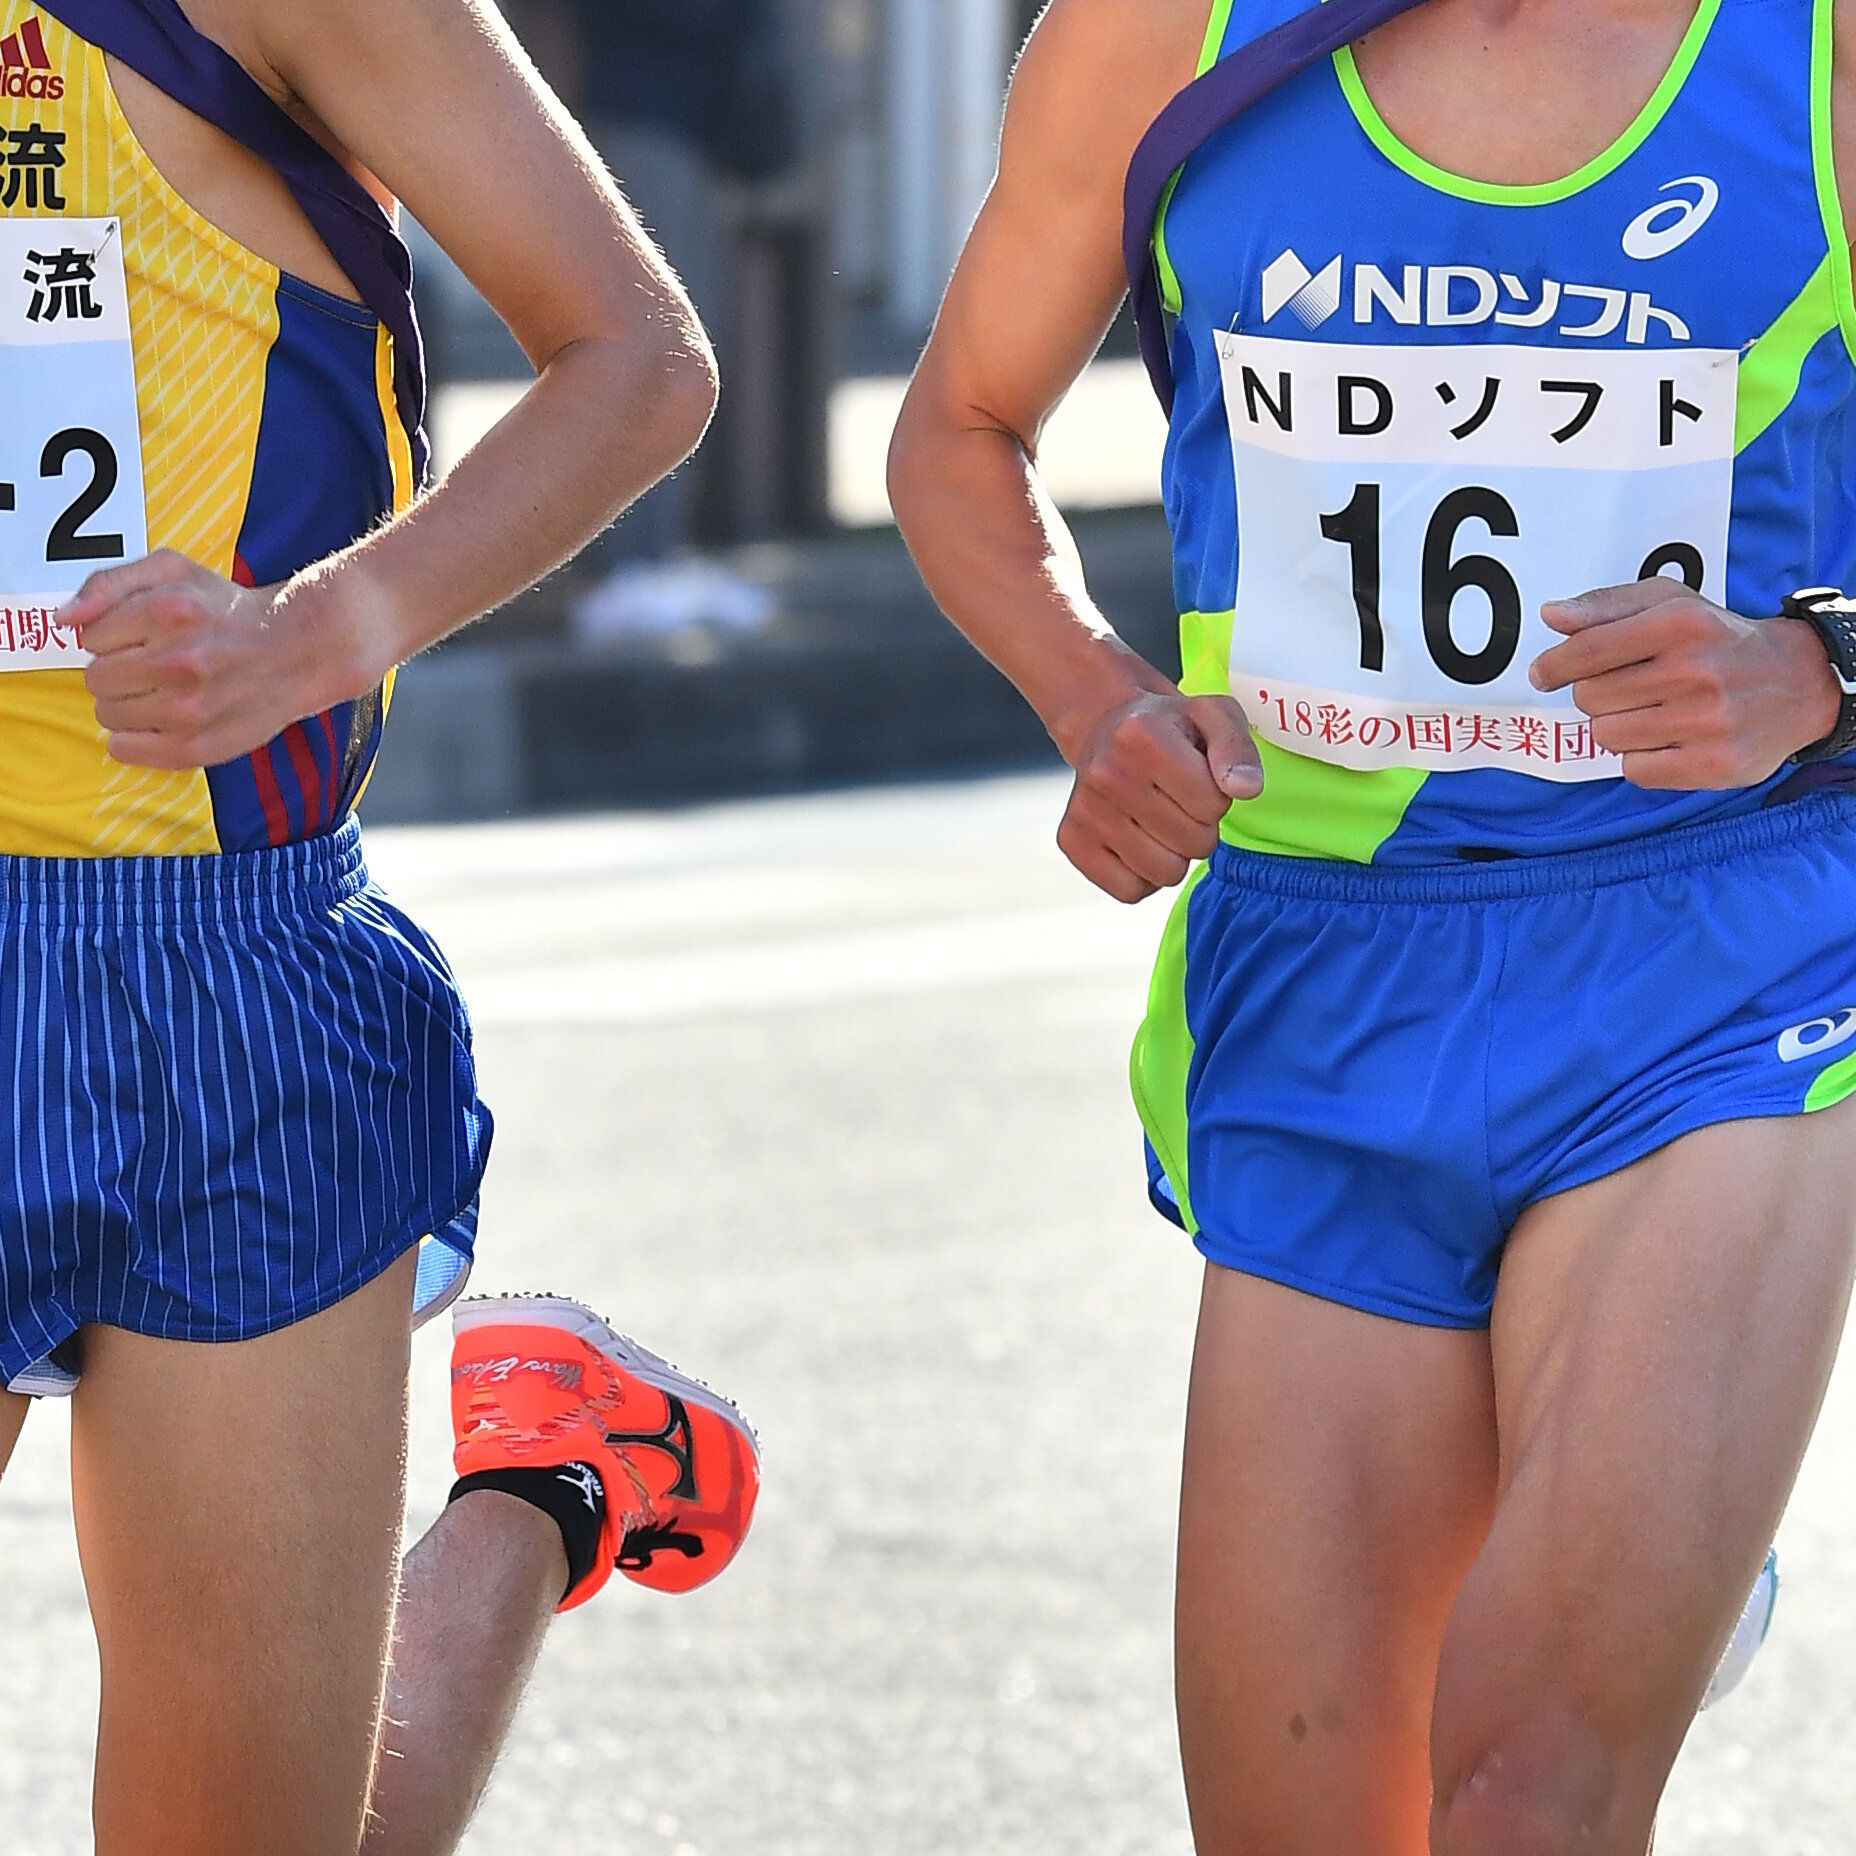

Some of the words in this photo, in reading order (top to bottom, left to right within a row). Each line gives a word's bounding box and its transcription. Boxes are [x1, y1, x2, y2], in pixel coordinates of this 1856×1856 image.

[1354, 261, 1691, 343] NDソフト
[1241, 365, 1703, 447] NDソフト
